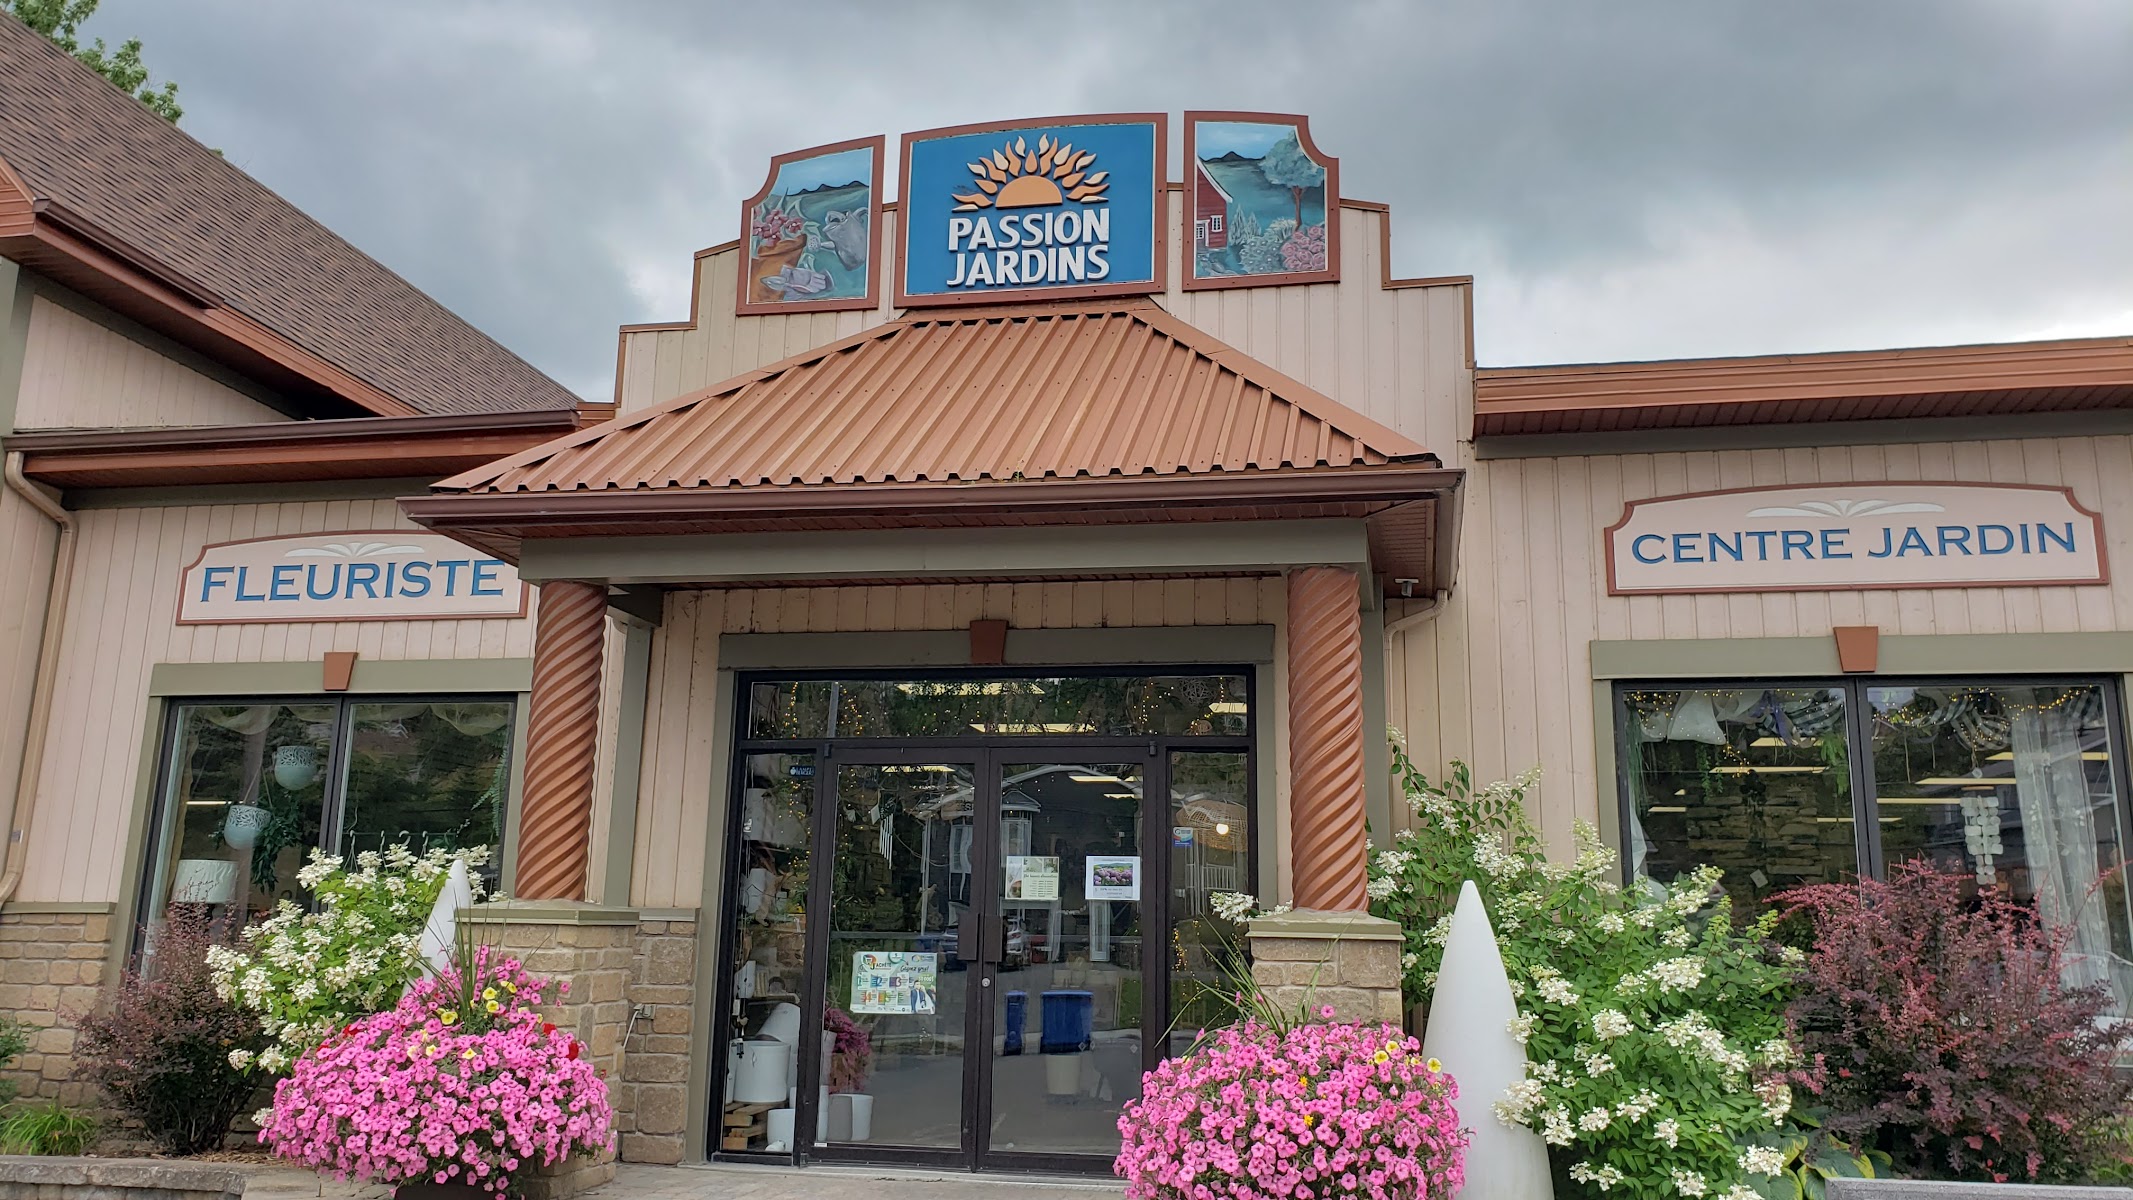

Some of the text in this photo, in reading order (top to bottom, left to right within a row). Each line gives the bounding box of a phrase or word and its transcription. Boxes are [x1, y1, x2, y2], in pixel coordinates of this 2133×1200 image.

[948, 208, 1110, 251] PASSION
[946, 245, 1110, 287] JARDINS
[1631, 521, 2077, 564] CENTRE JARDIN
[200, 559, 505, 602] FLEURISTE
